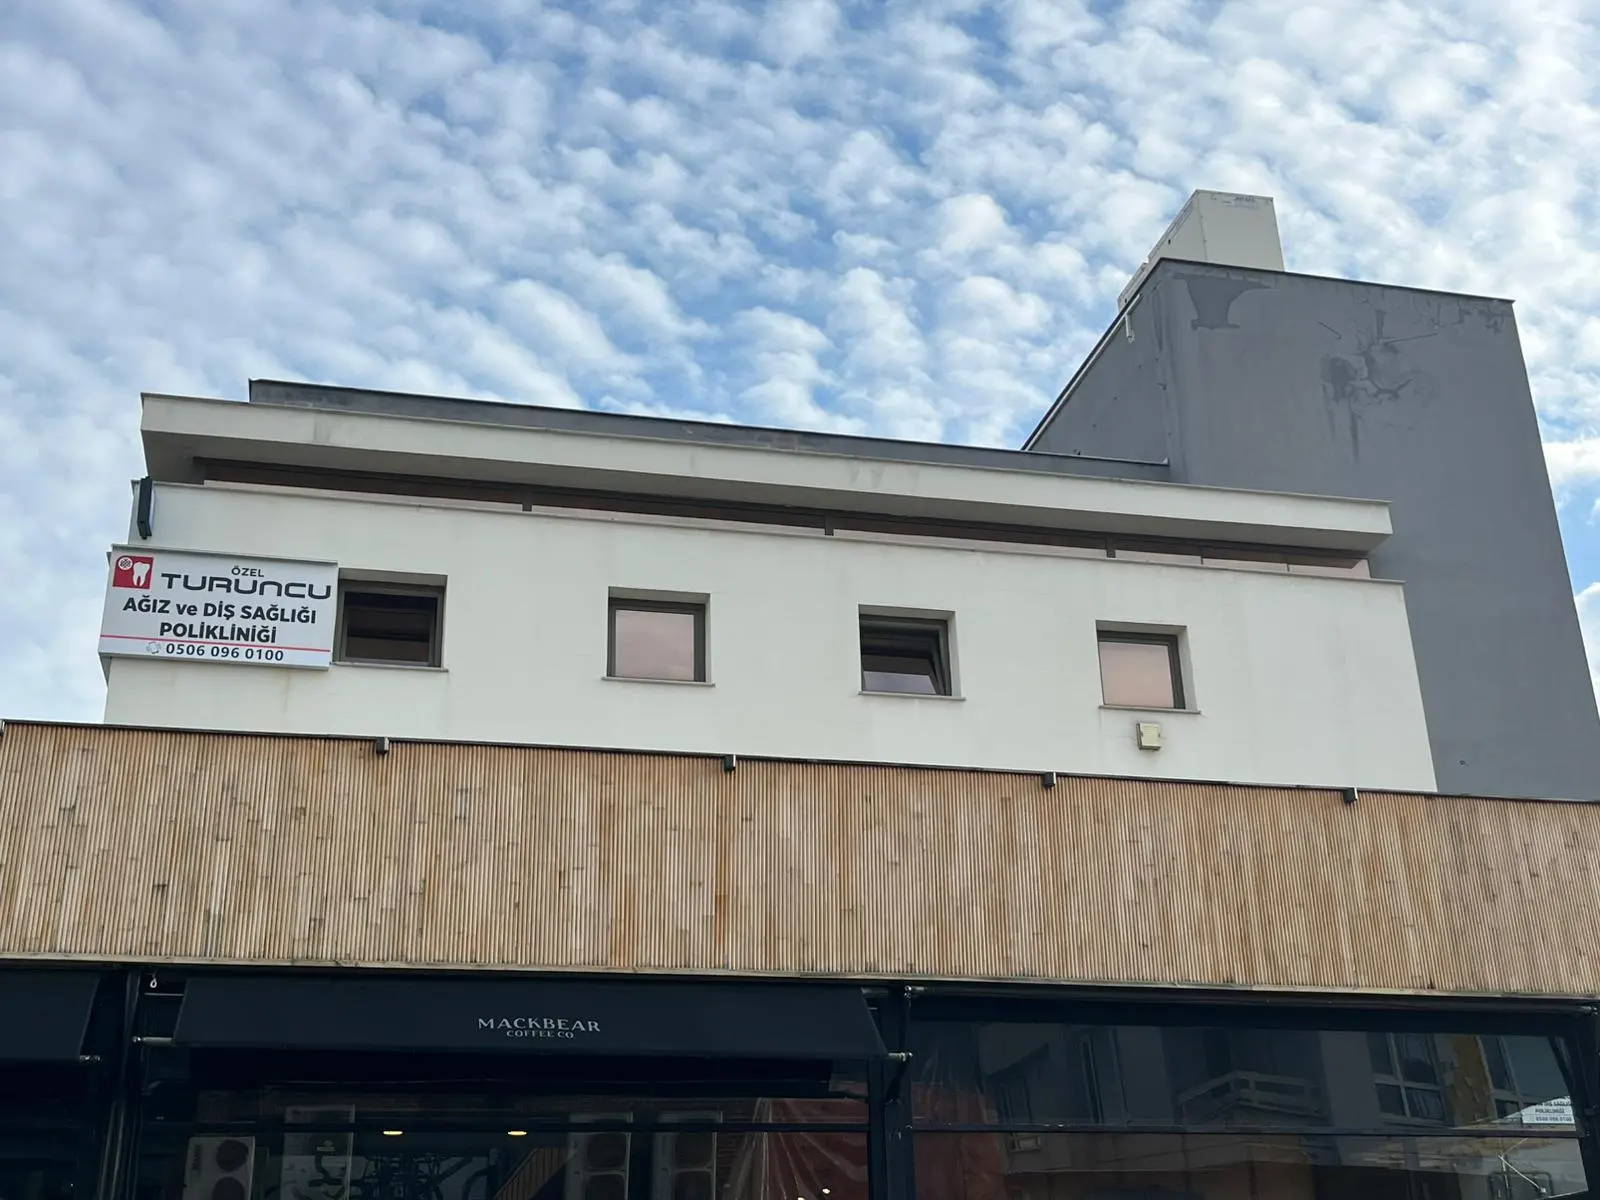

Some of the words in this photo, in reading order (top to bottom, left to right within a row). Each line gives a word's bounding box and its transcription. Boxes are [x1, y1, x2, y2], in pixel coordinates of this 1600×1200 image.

[231, 565, 265, 578] ÖZEL
[123, 595, 171, 614] AĞIZ
[176, 604, 198, 616] ve
[203, 601, 235, 621] DİŞ
[240, 604, 316, 624] SAĞLIĞI
[159, 621, 277, 643] POLİKLİNİĞİ
[166, 643, 205, 657] 0506
[210, 646, 239, 659] 096
[245, 648, 284, 661] 0100
[478, 1017, 600, 1032] MACKBEAR
